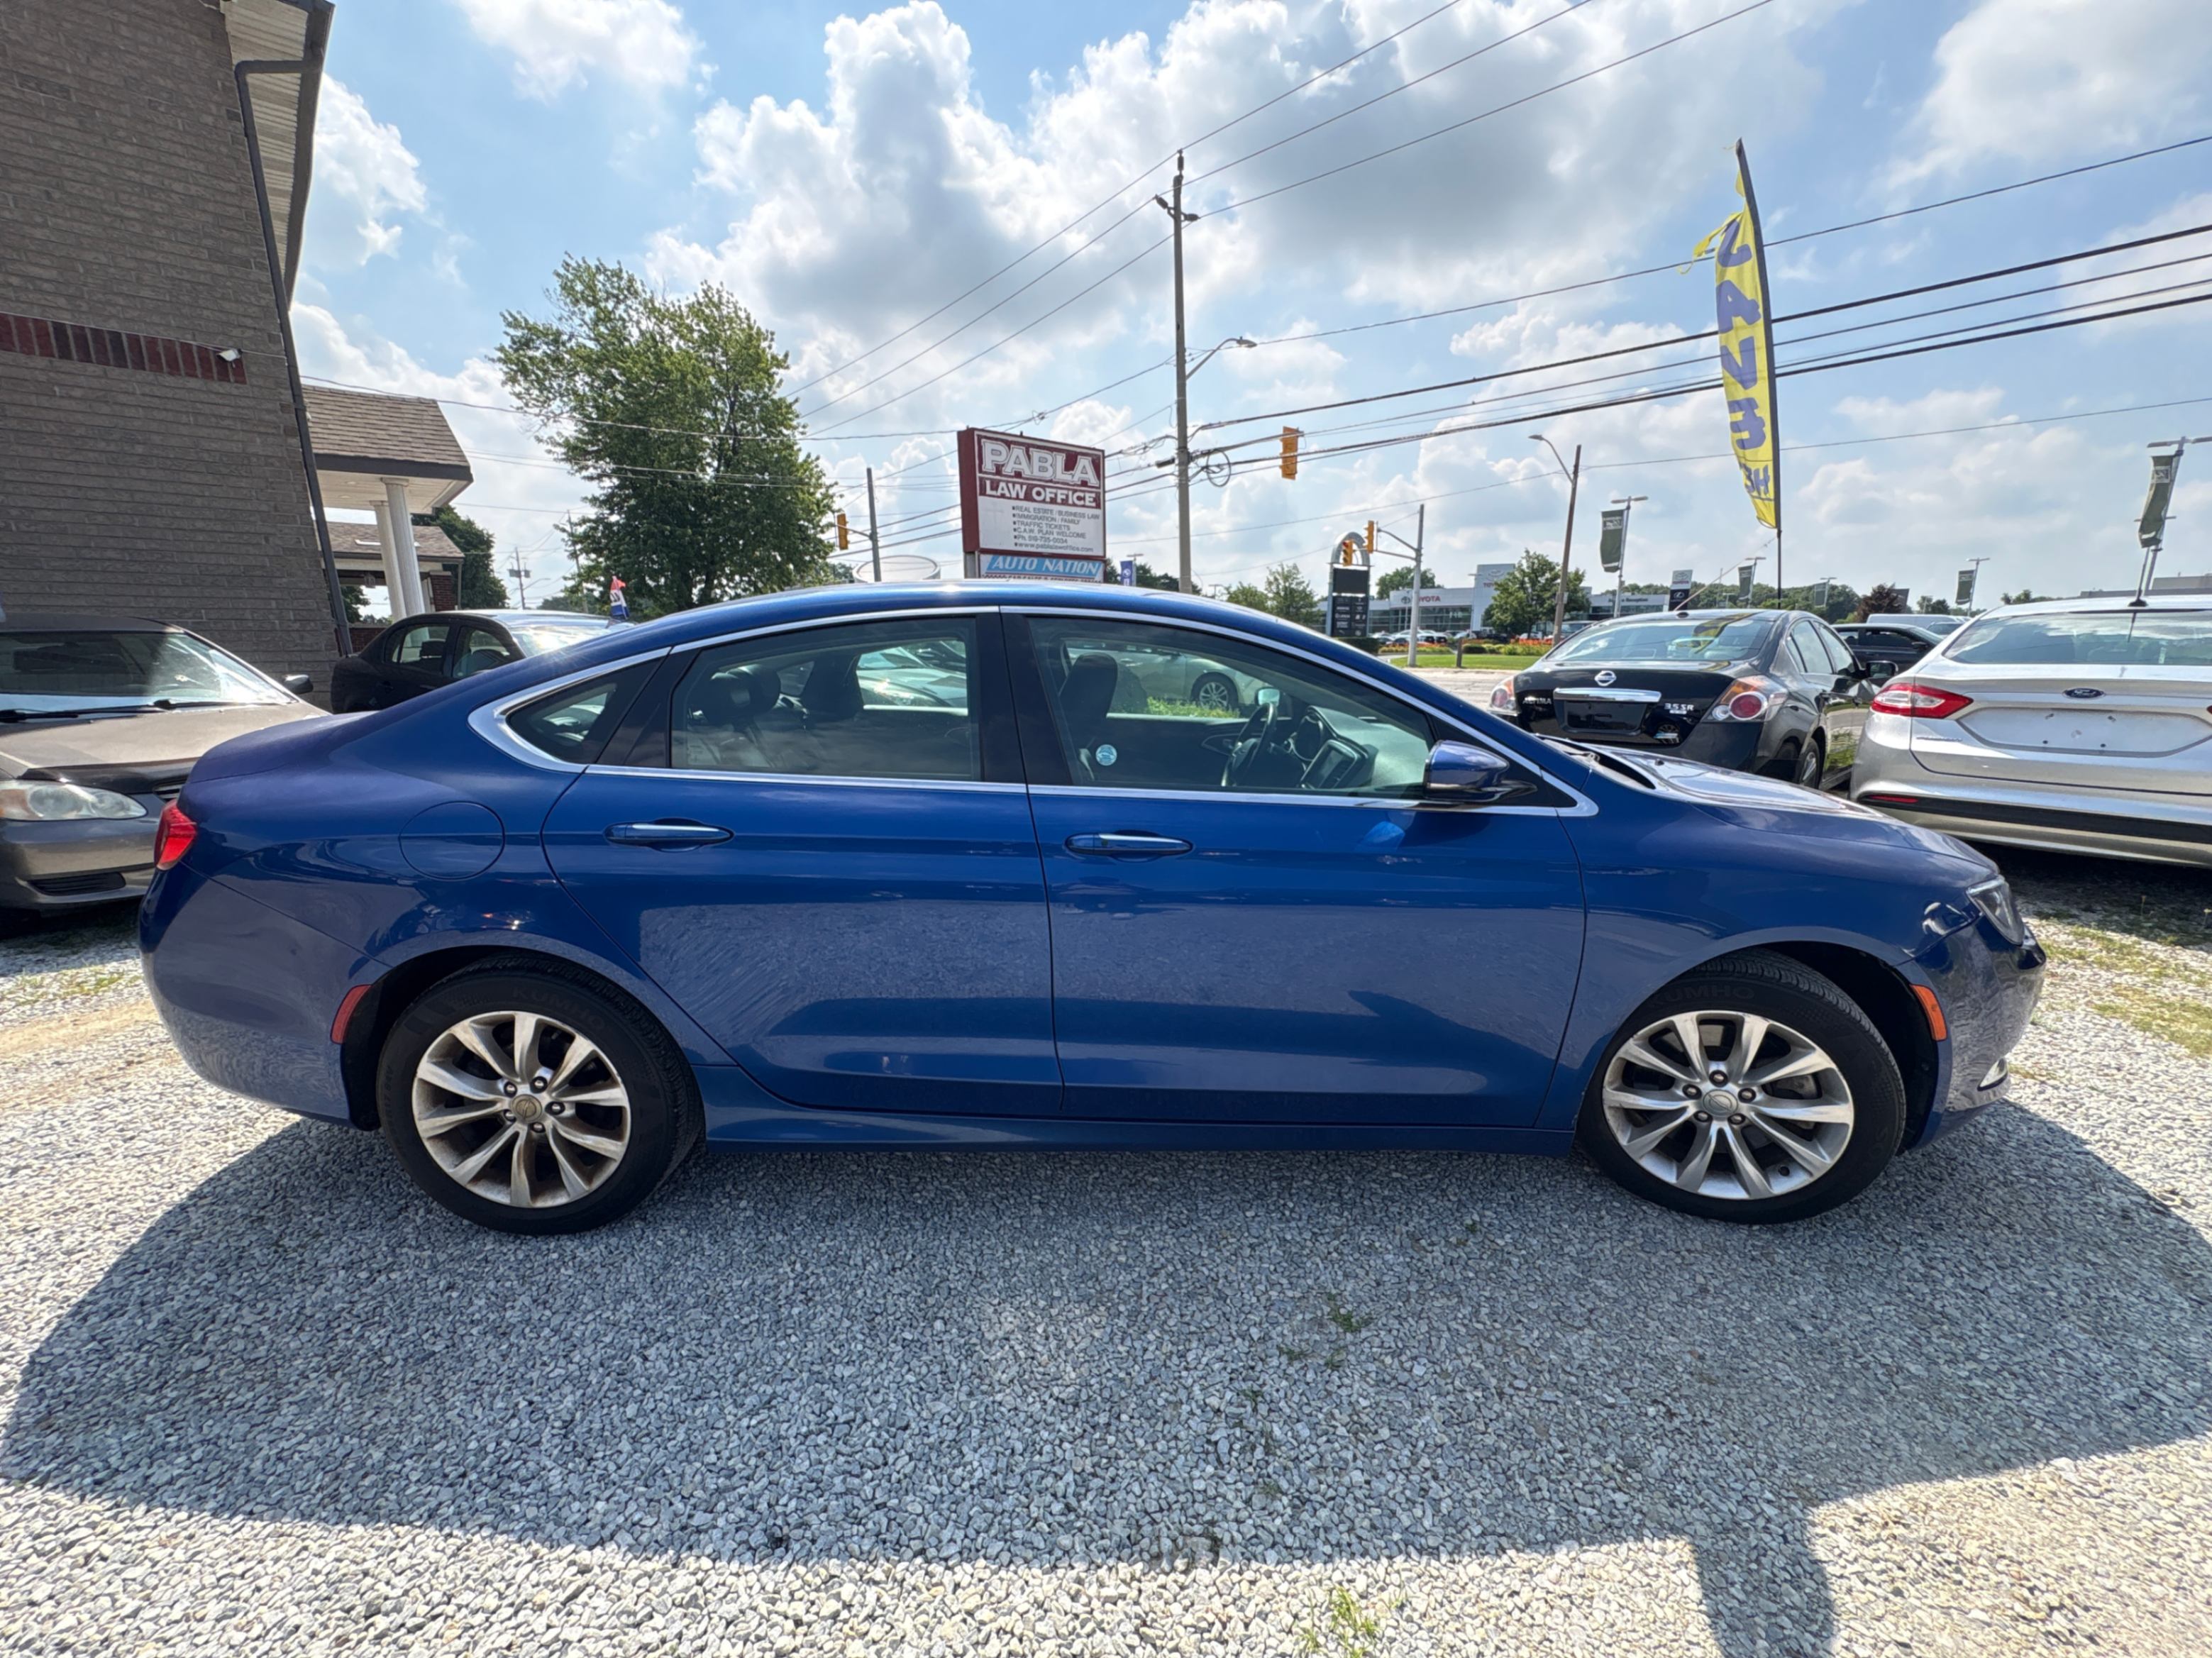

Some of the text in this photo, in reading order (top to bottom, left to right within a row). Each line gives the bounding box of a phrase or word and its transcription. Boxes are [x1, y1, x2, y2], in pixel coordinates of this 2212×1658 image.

[981, 438, 1100, 487] PABLA
[985, 480, 1096, 507] LAW OFFICE
[1016, 513, 1056, 523] IMMIGRATION
[1058, 509, 1085, 519] BUSINESS
[1017, 520, 1071, 531] TRAFFIC TICKETS
[1056, 531, 1086, 539] WELCOME
[992, 556, 1099, 575] AUTO NATION
